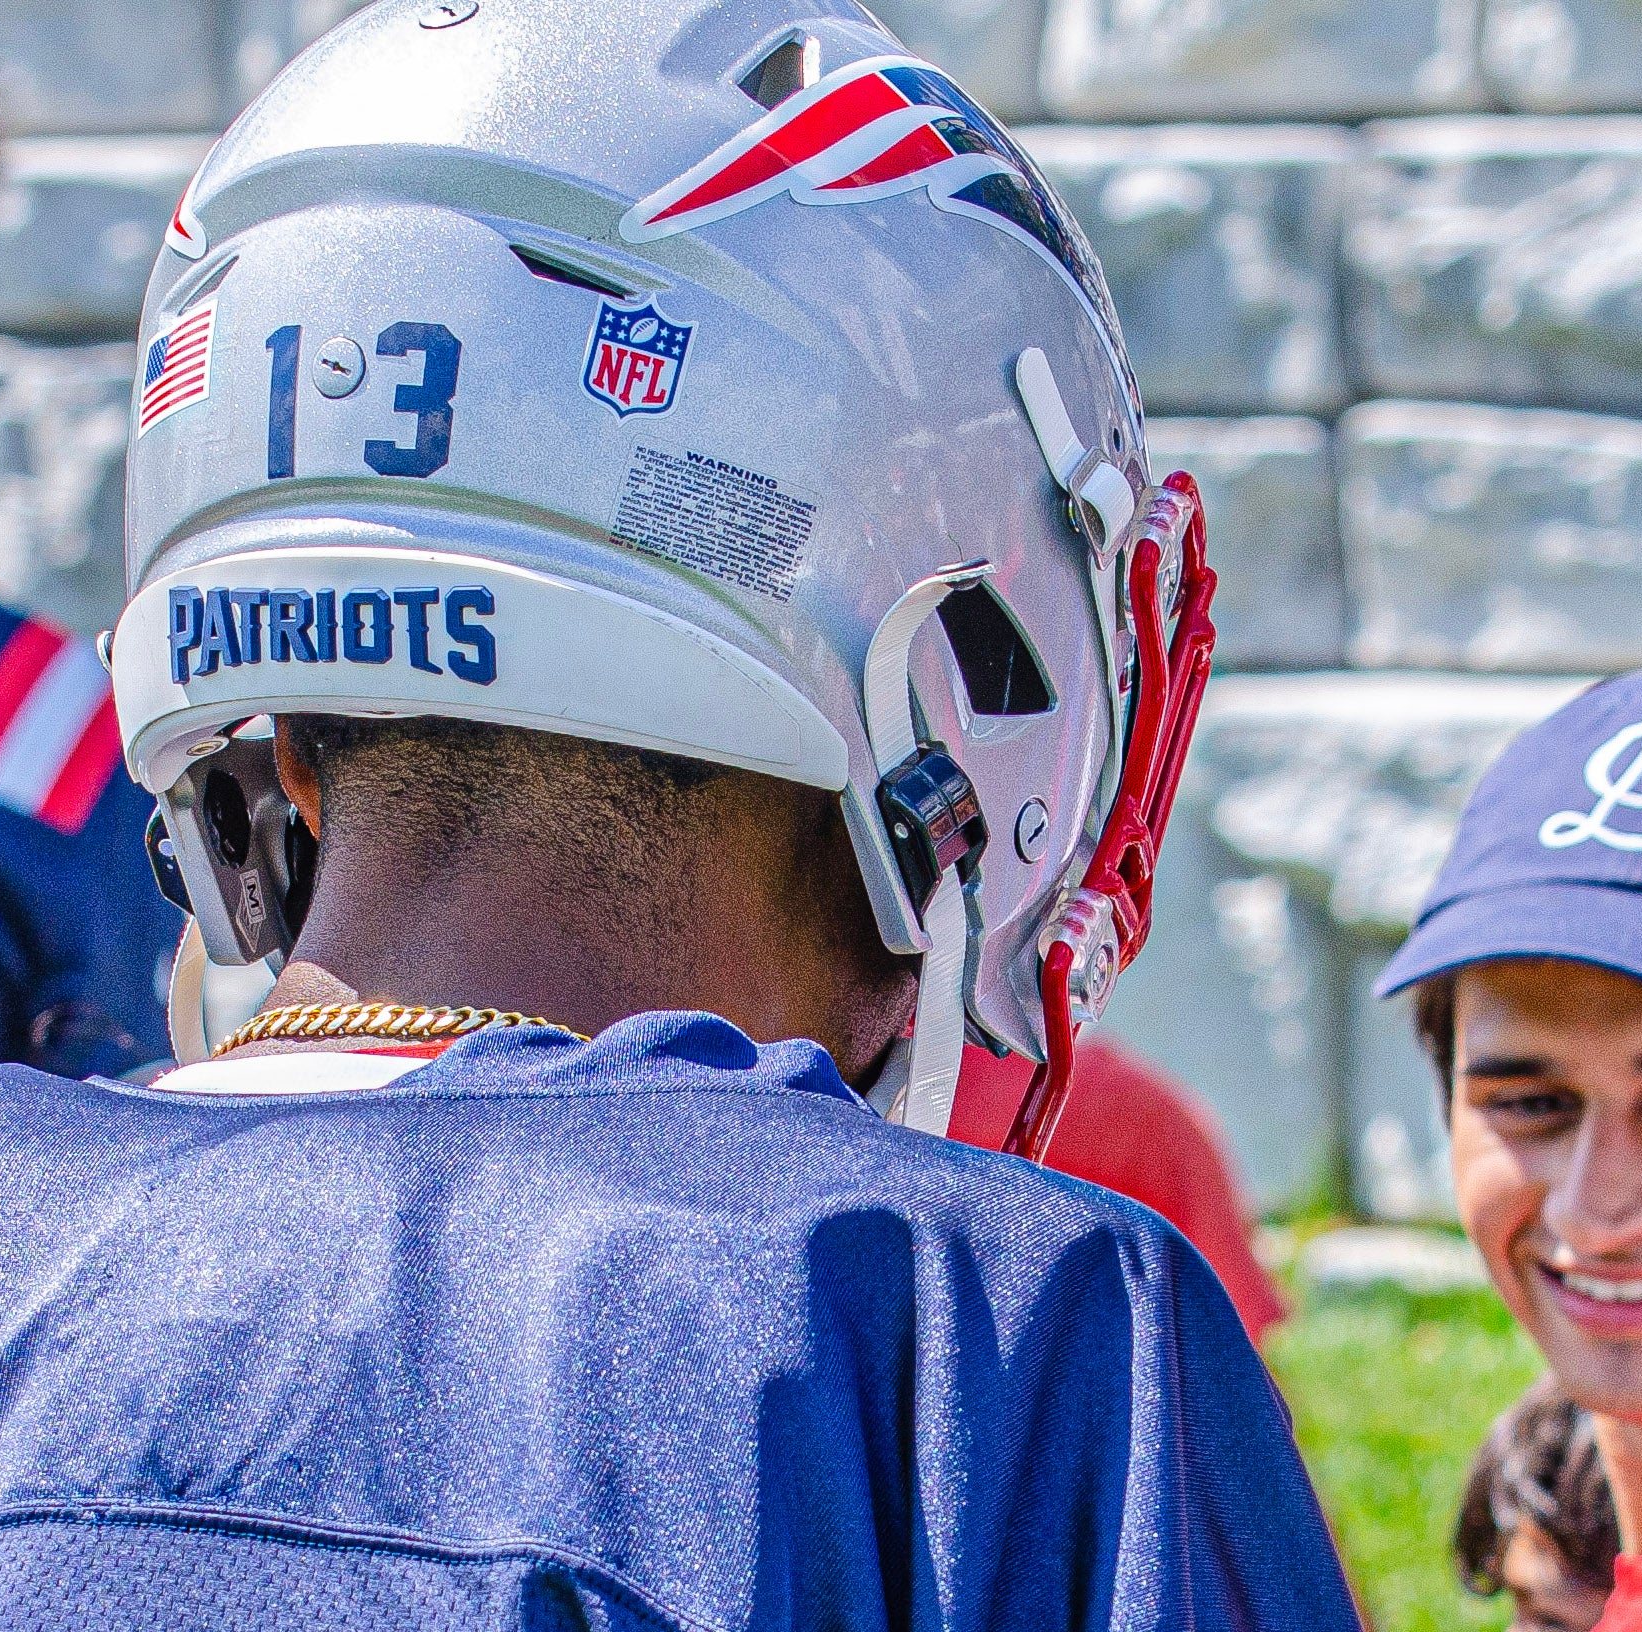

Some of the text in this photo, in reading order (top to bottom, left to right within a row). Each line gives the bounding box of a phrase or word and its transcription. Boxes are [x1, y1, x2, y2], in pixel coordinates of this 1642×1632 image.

[265, 321, 463, 480] 13
[592, 343, 667, 406] NFL
[686, 450, 778, 489] WARNING
[168, 585, 497, 686] PATRIOTS
